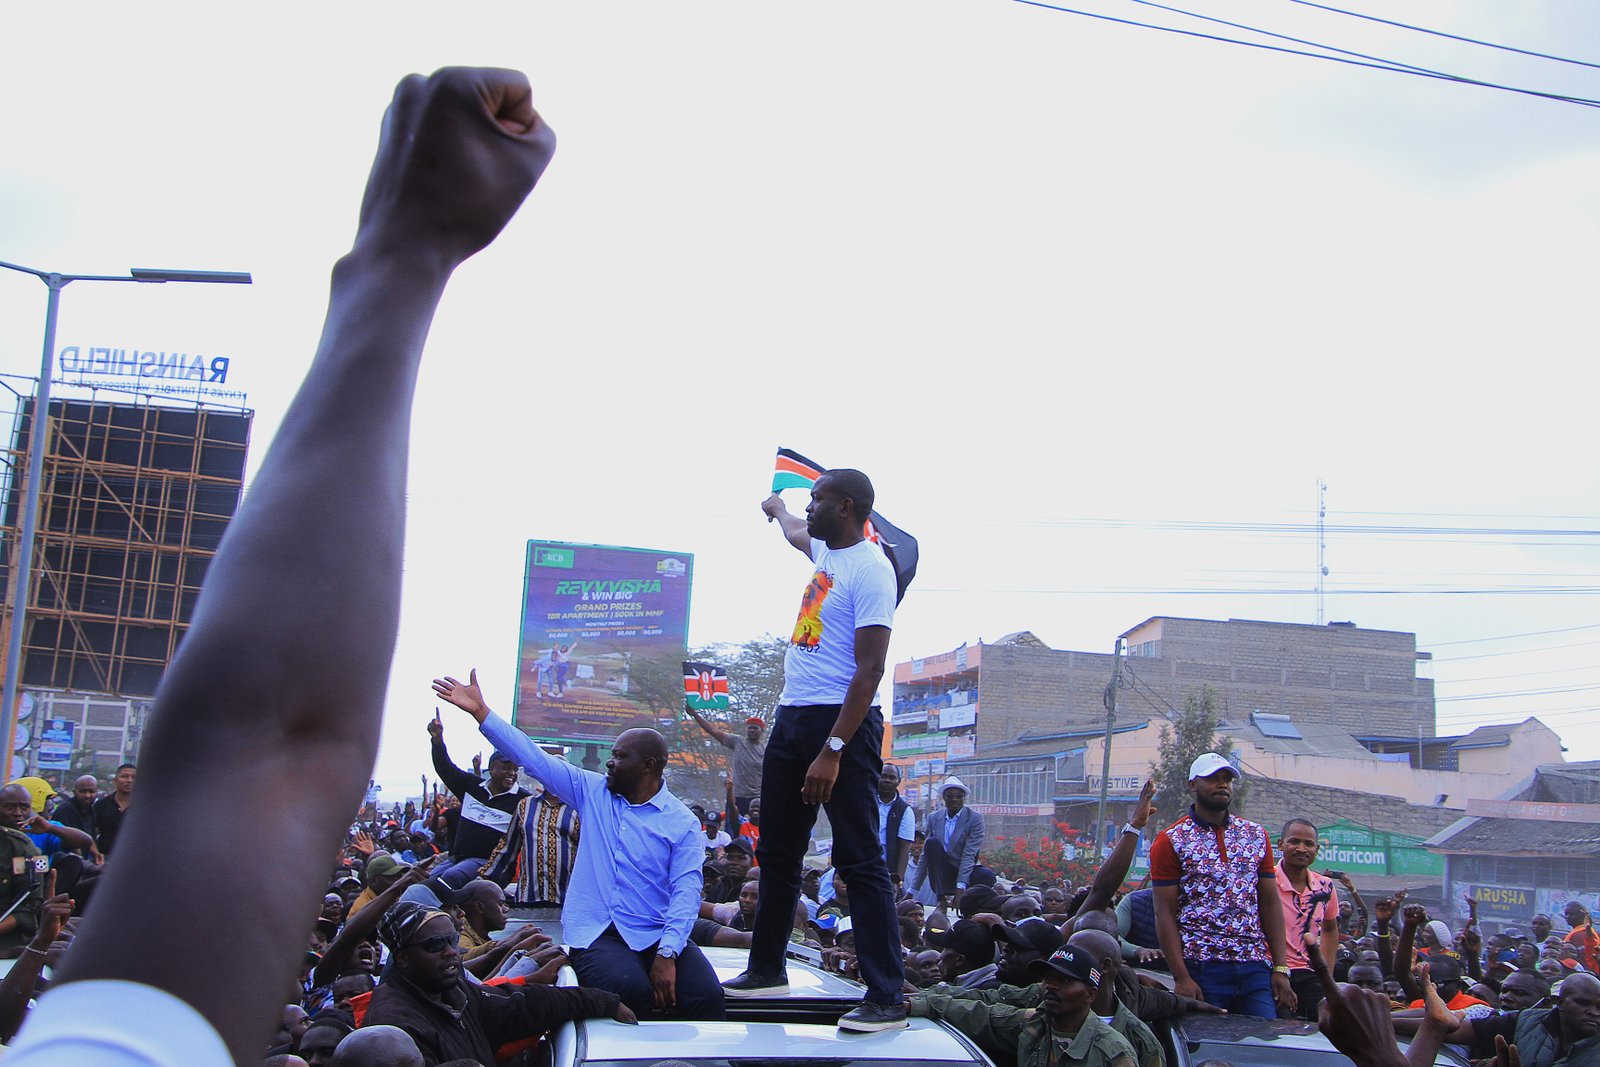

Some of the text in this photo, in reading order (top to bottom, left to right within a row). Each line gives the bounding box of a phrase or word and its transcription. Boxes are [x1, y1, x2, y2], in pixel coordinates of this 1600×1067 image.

[547, 553, 564, 562] KCB
[582, 591, 633, 600] & WIN BIG
[574, 602, 642, 611] GRAND PRIZES
[562, 611, 609, 620] APARTMENT
[1316, 845, 1385, 864] Safaricom
[1475, 887, 1527, 905] ARUSHA
